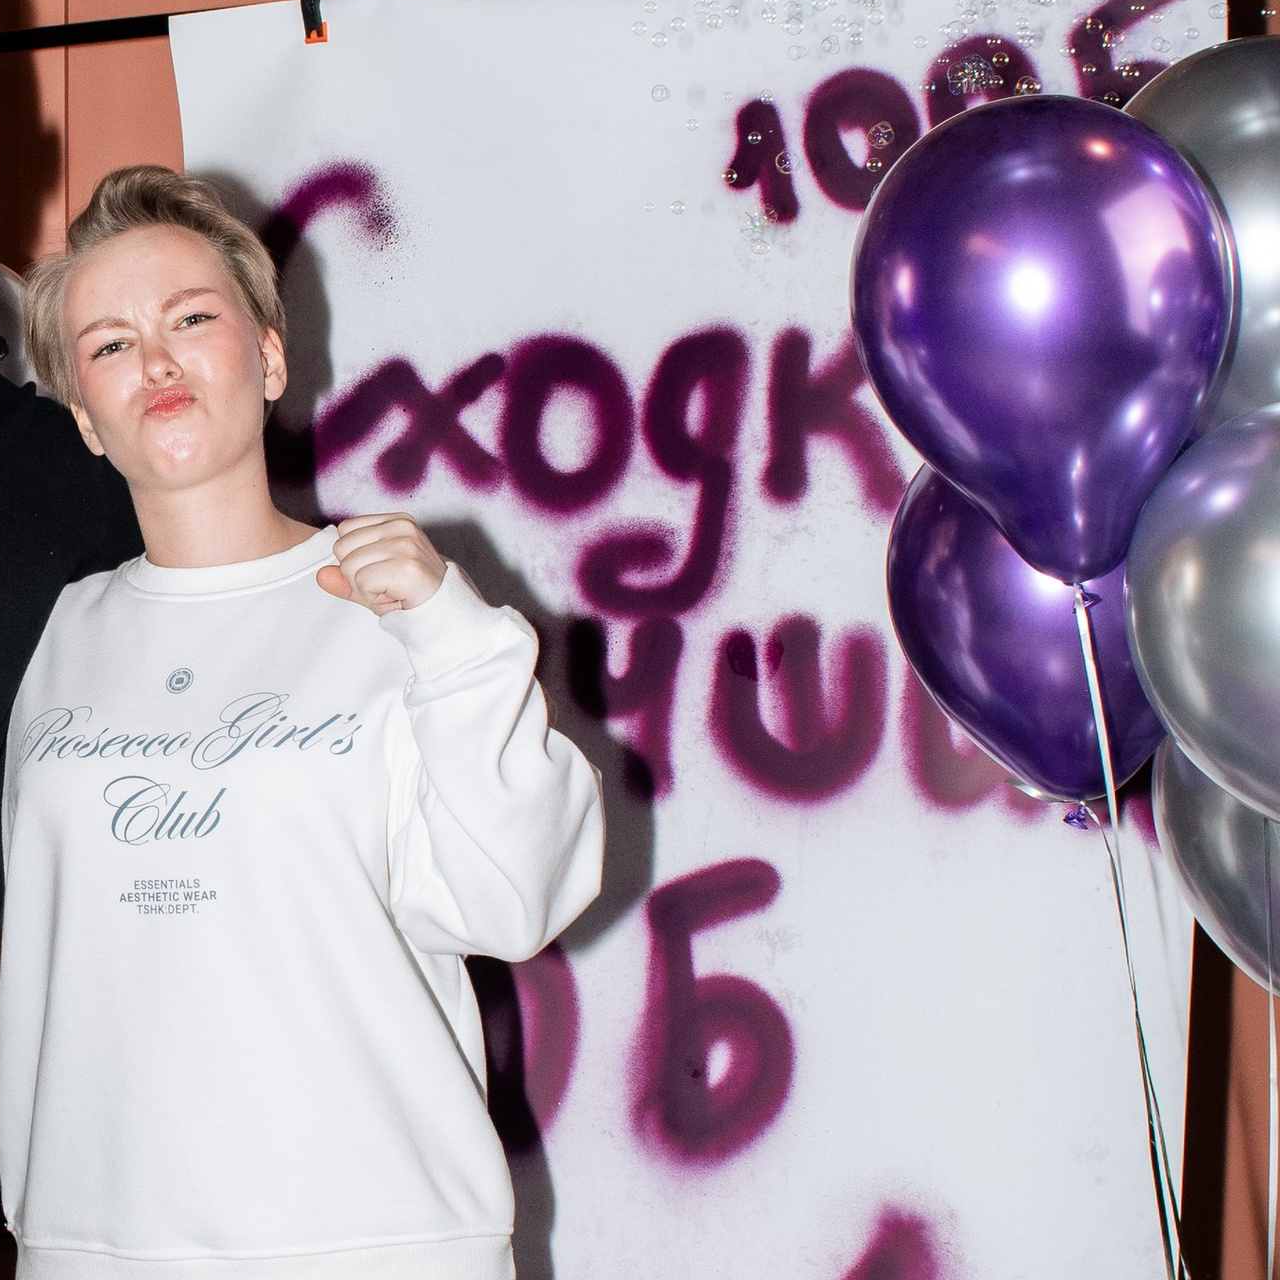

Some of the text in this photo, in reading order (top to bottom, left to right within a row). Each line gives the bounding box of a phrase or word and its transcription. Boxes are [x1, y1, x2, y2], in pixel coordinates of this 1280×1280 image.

[17, 691, 363, 773] Prosecco Girl's
[103, 775, 227, 846] Club
[133, 878, 201, 890] ESSENTIALS
[119, 890, 218, 903] AESTHETIC WEAR
[136, 903, 200, 915] TSHK:DEPT.
